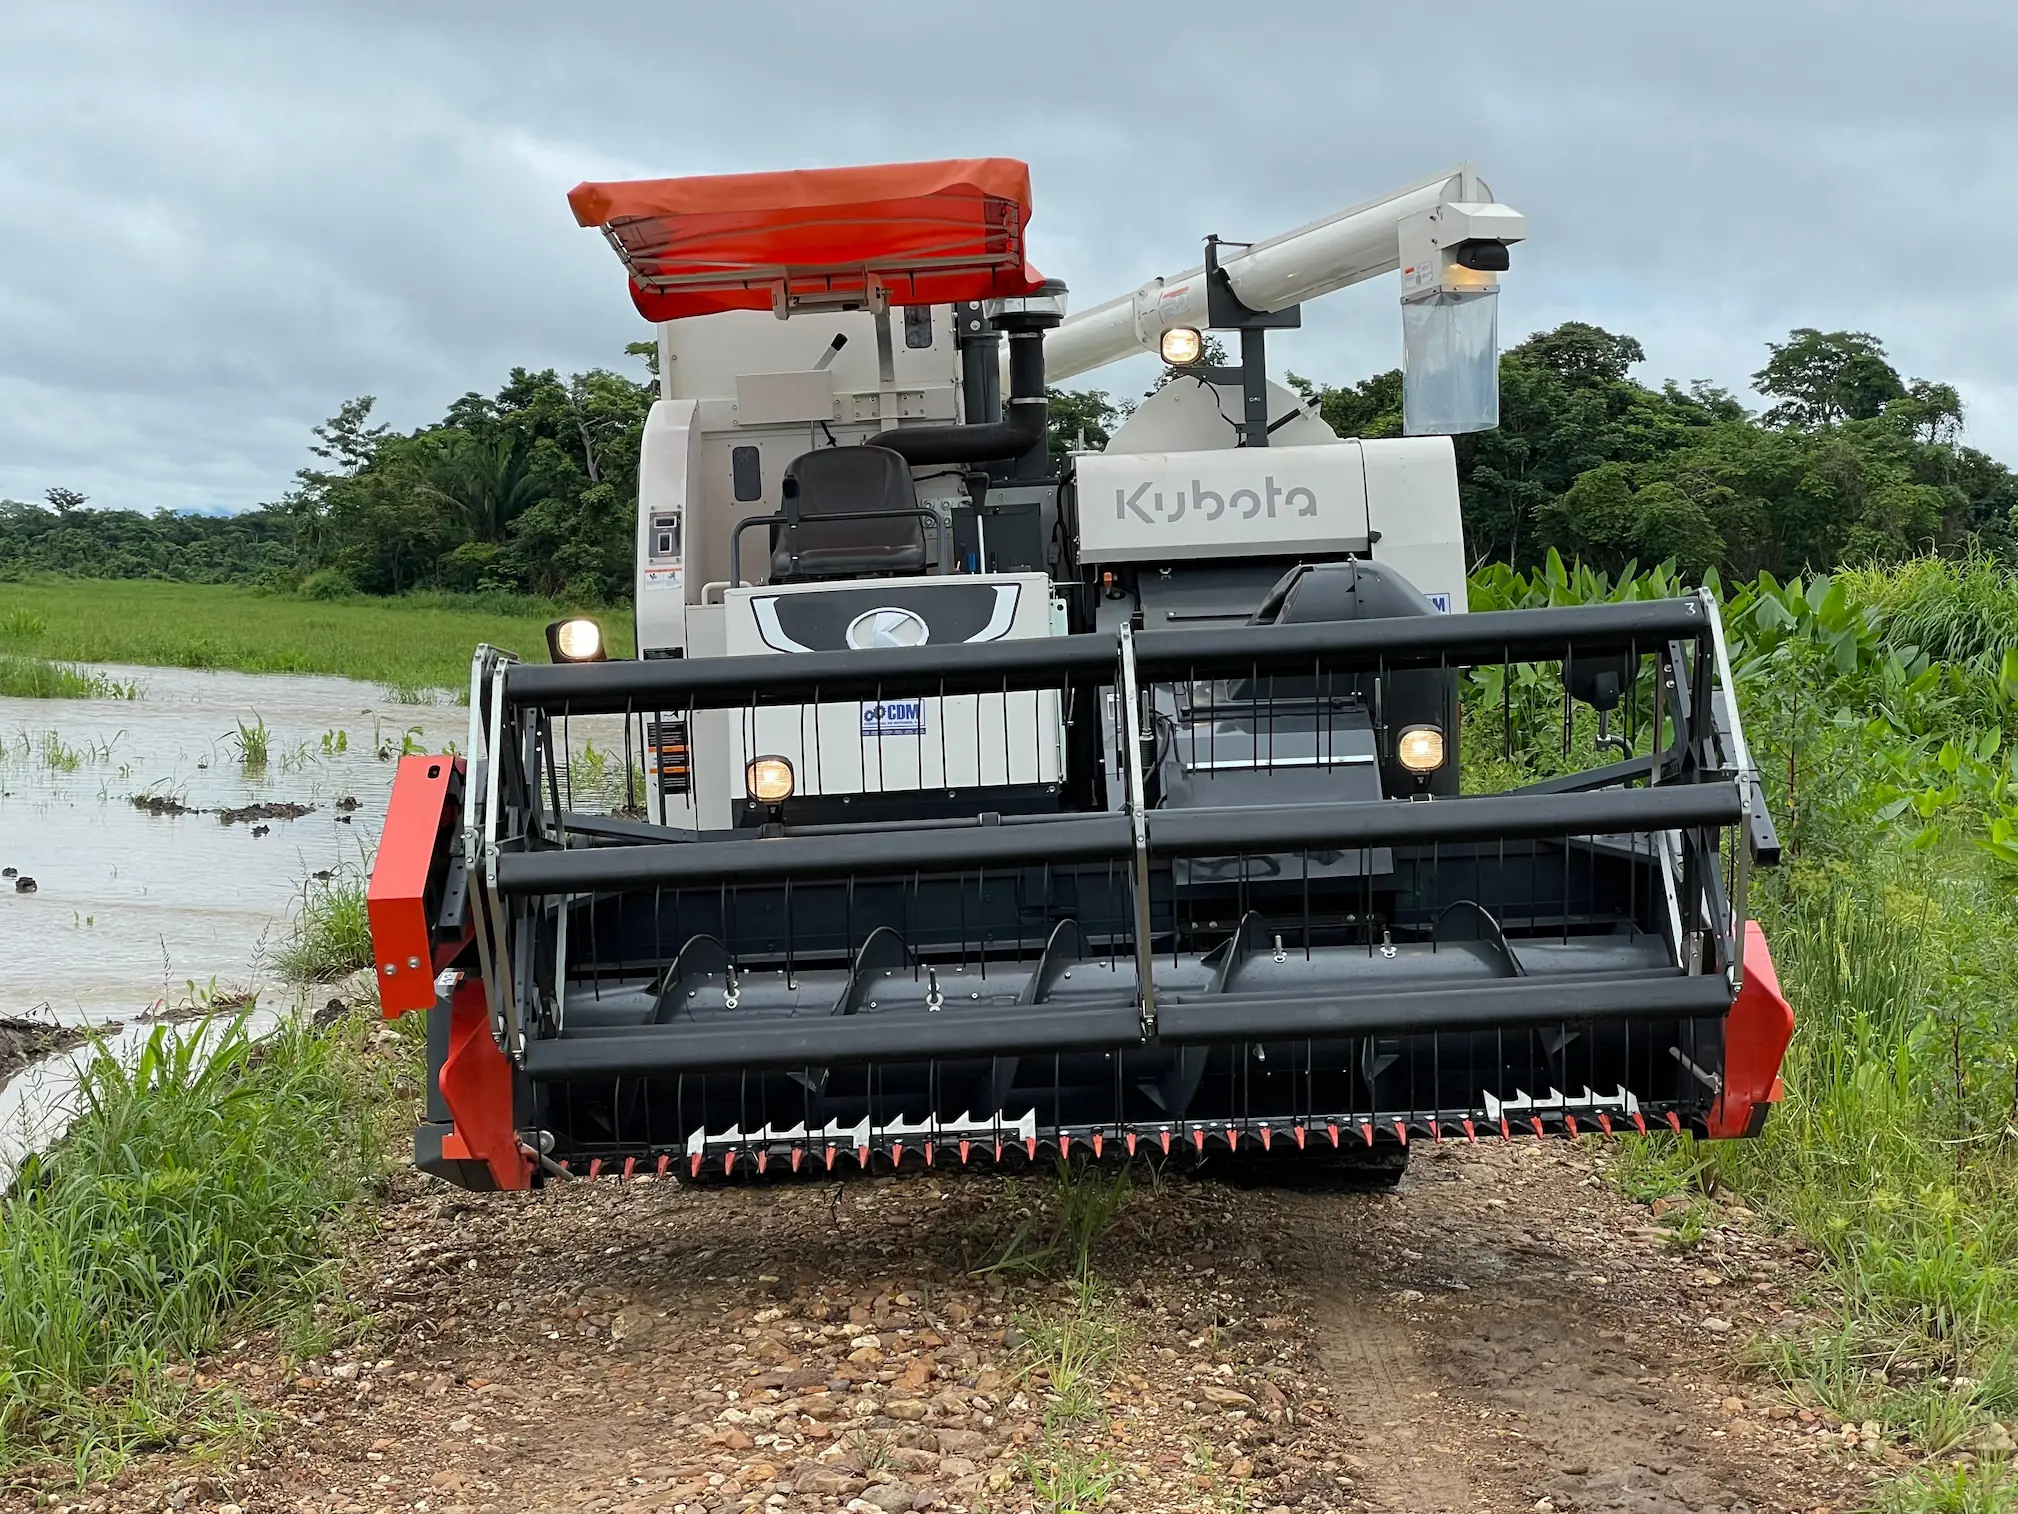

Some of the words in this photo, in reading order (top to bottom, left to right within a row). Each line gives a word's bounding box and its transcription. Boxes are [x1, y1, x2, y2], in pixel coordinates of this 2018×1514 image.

[1115, 476, 1318, 524] Kubota
[1684, 602, 1697, 617] 3
[887, 704, 920, 720] CDM
